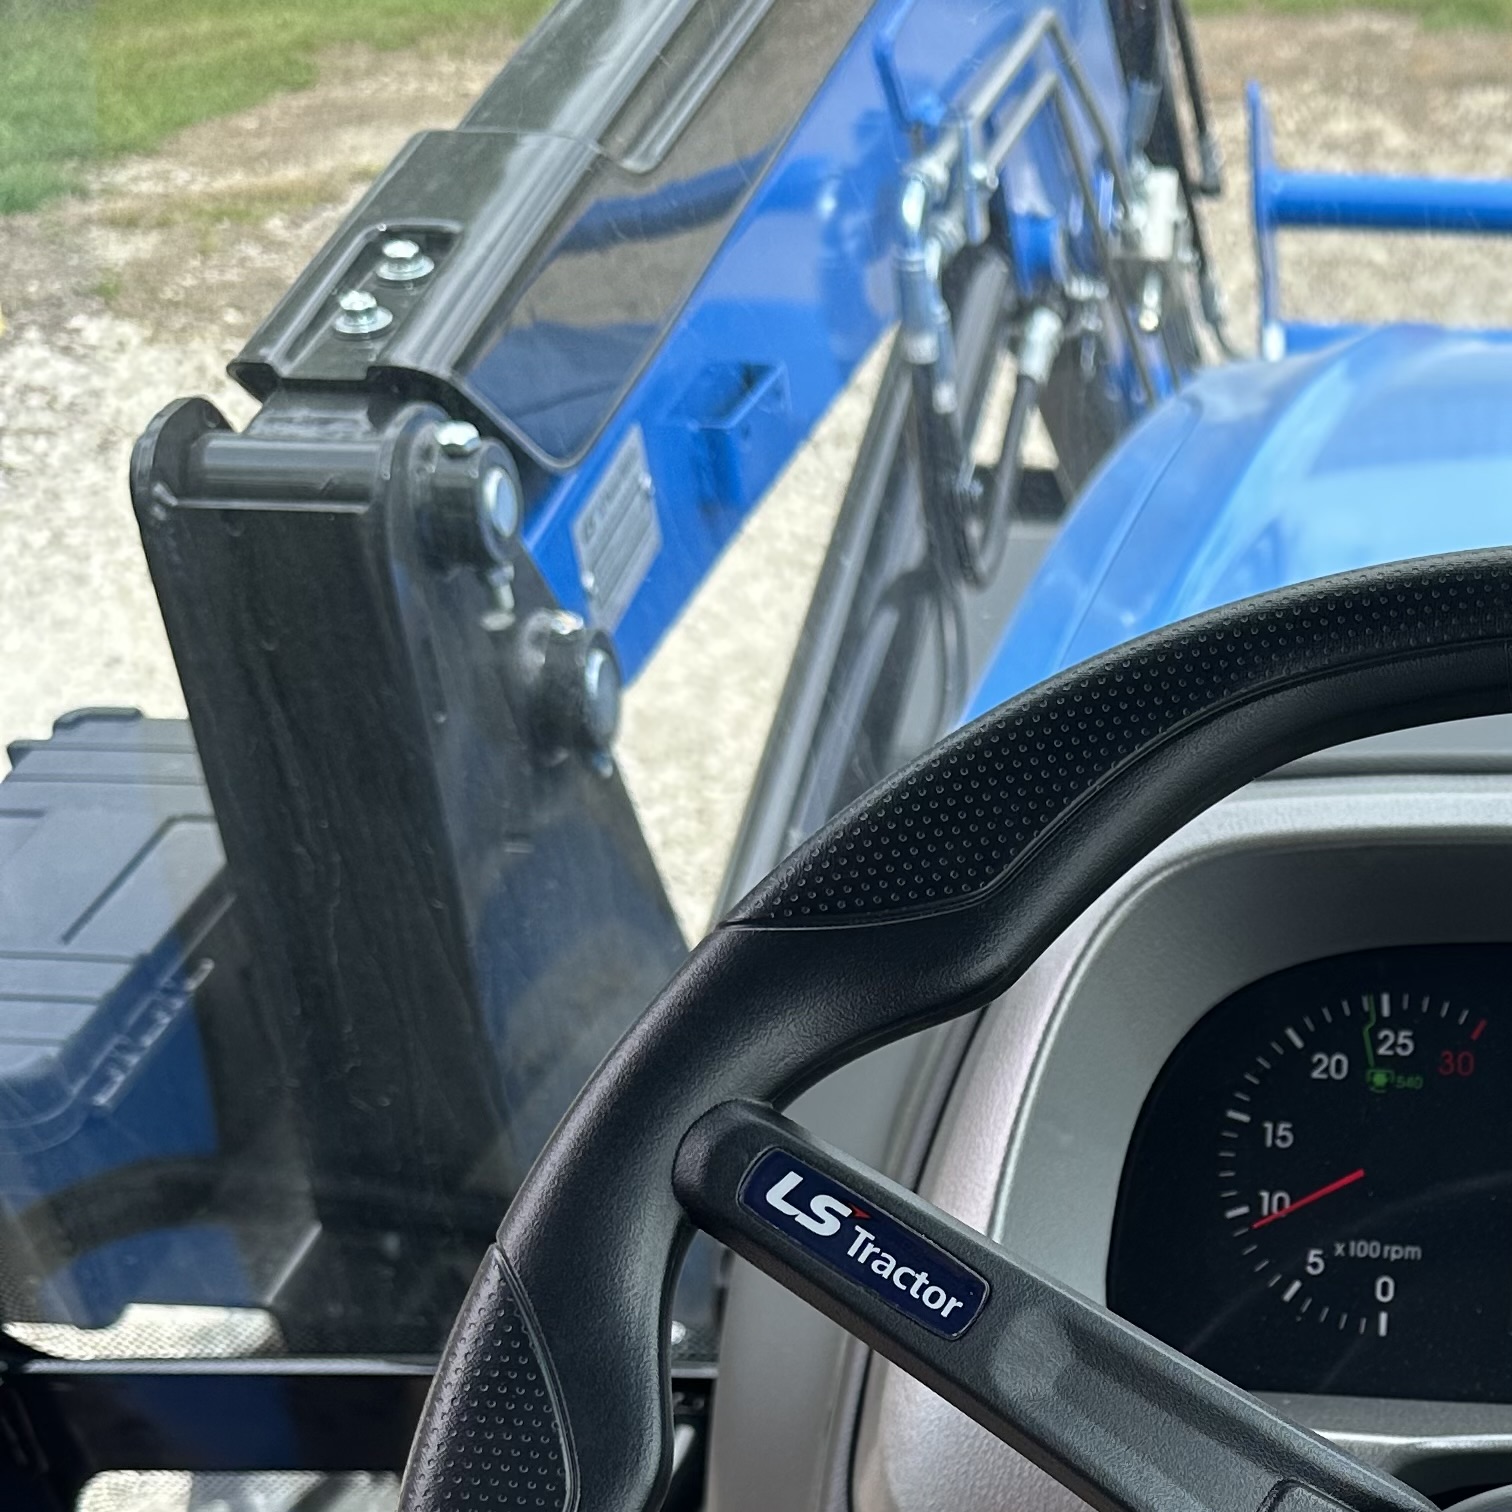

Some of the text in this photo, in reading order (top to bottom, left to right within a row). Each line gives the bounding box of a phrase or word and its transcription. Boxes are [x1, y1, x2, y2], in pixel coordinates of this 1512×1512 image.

[1377, 1030, 1415, 1056] 25
[1311, 1053, 1349, 1080] 20
[1438, 1051, 1475, 1076] 30
[1262, 1122, 1294, 1148] 15
[1259, 1191, 1292, 1217] 10
[766, 1171, 963, 1318] LS Tractor
[1383, 1244, 1422, 1262] rpm
[1306, 1250, 1325, 1275] 5
[1375, 1276, 1395, 1302] 0
